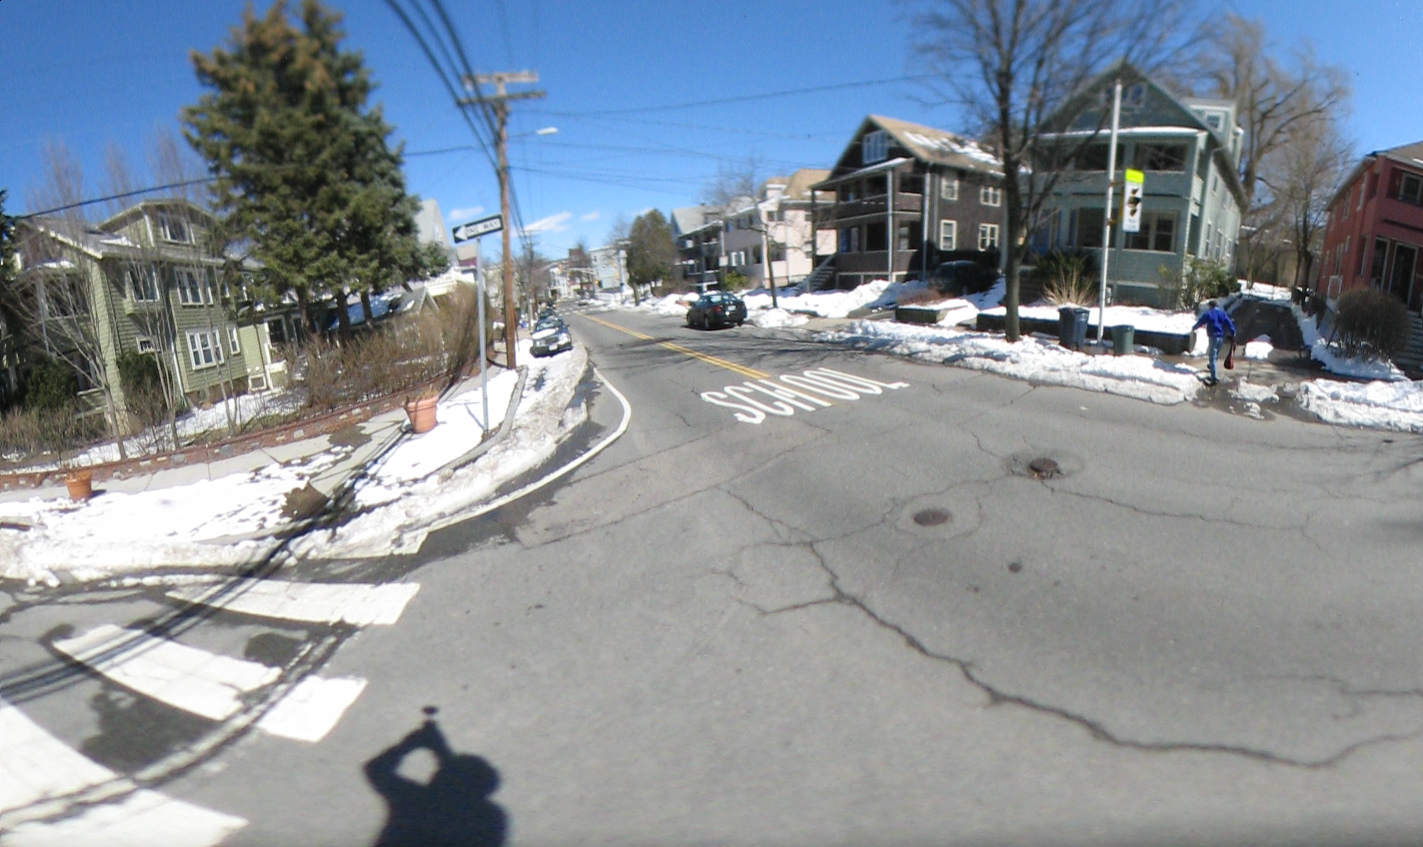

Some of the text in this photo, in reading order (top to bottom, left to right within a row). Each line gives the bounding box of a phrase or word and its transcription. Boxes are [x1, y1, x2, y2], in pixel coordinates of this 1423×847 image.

[464, 221, 499, 236] ONE WAY
[700, 367, 910, 424] SCHOOL
